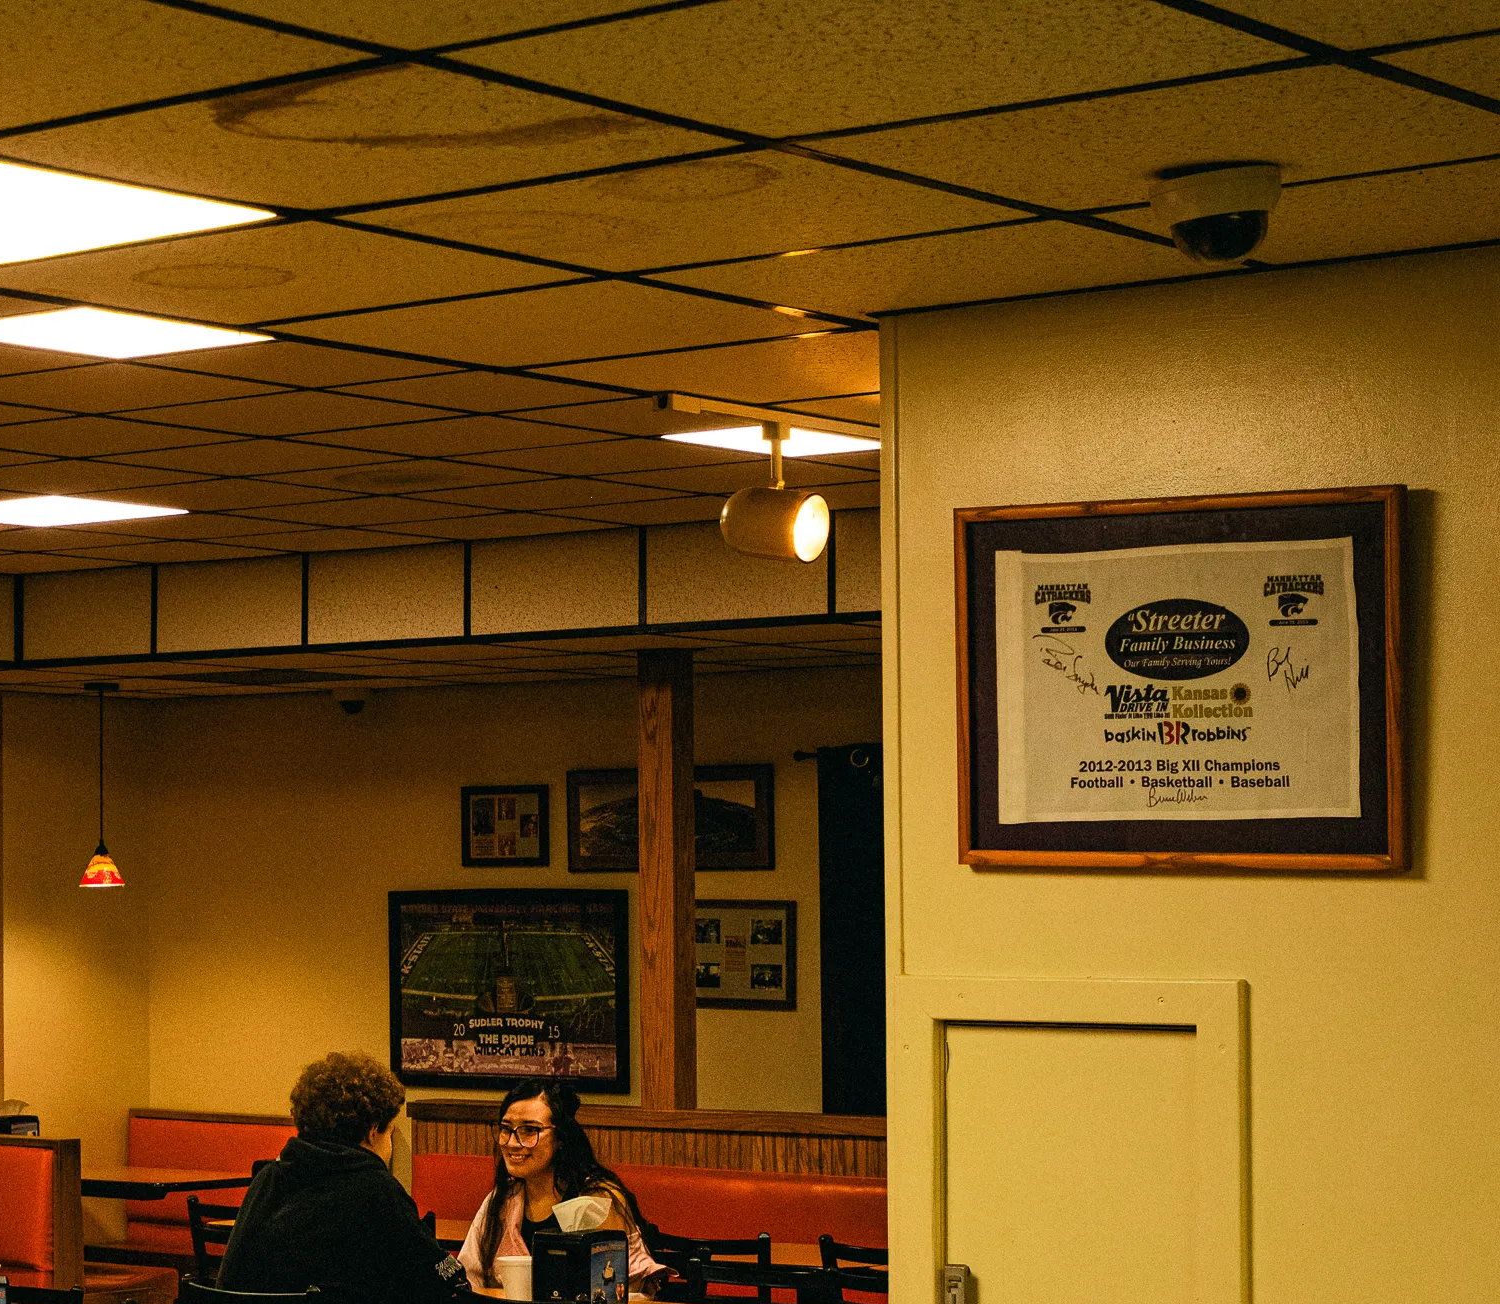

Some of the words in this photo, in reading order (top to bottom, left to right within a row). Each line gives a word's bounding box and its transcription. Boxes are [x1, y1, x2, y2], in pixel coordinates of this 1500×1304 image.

[1266, 574, 1322, 582] MANHATTAN
[1037, 583, 1089, 591] MANHATTAN
[1132, 609, 1226, 632] Streeter
[1119, 636, 1169, 654] Family
[1173, 635, 1236, 651] Business
[1124, 659, 1141, 668] Our
[1141, 657, 1170, 669] Family
[1171, 656, 1202, 669] Serving
[1203, 656, 1232, 667] Yours!
[1104, 684, 1171, 713] Vista
[1172, 686, 1228, 700] Kansas
[1119, 702, 1154, 713] DRIVE
[1156, 701, 1169, 712] IN
[1172, 703, 1253, 718] Kollection
[1079, 759, 1151, 773] 2012-2013
[1156, 759, 1179, 774] Big
[1182, 759, 1200, 772] XII
[1204, 759, 1280, 774] Champions
[1070, 776, 1123, 788] Football
[1141, 775, 1212, 788] Basketball
[1230, 775, 1290, 787] Baseball
[453, 1023, 466, 1037] 20
[469, 1017, 503, 1029] SUDLER
[505, 1017, 545, 1030] TROPHY
[548, 1025, 561, 1039] 15
[478, 1033, 499, 1045] THE
[501, 1034, 535, 1046] PRIDE
[474, 1046, 516, 1056] WILDCAT
[520, 1047, 546, 1057] LAND
